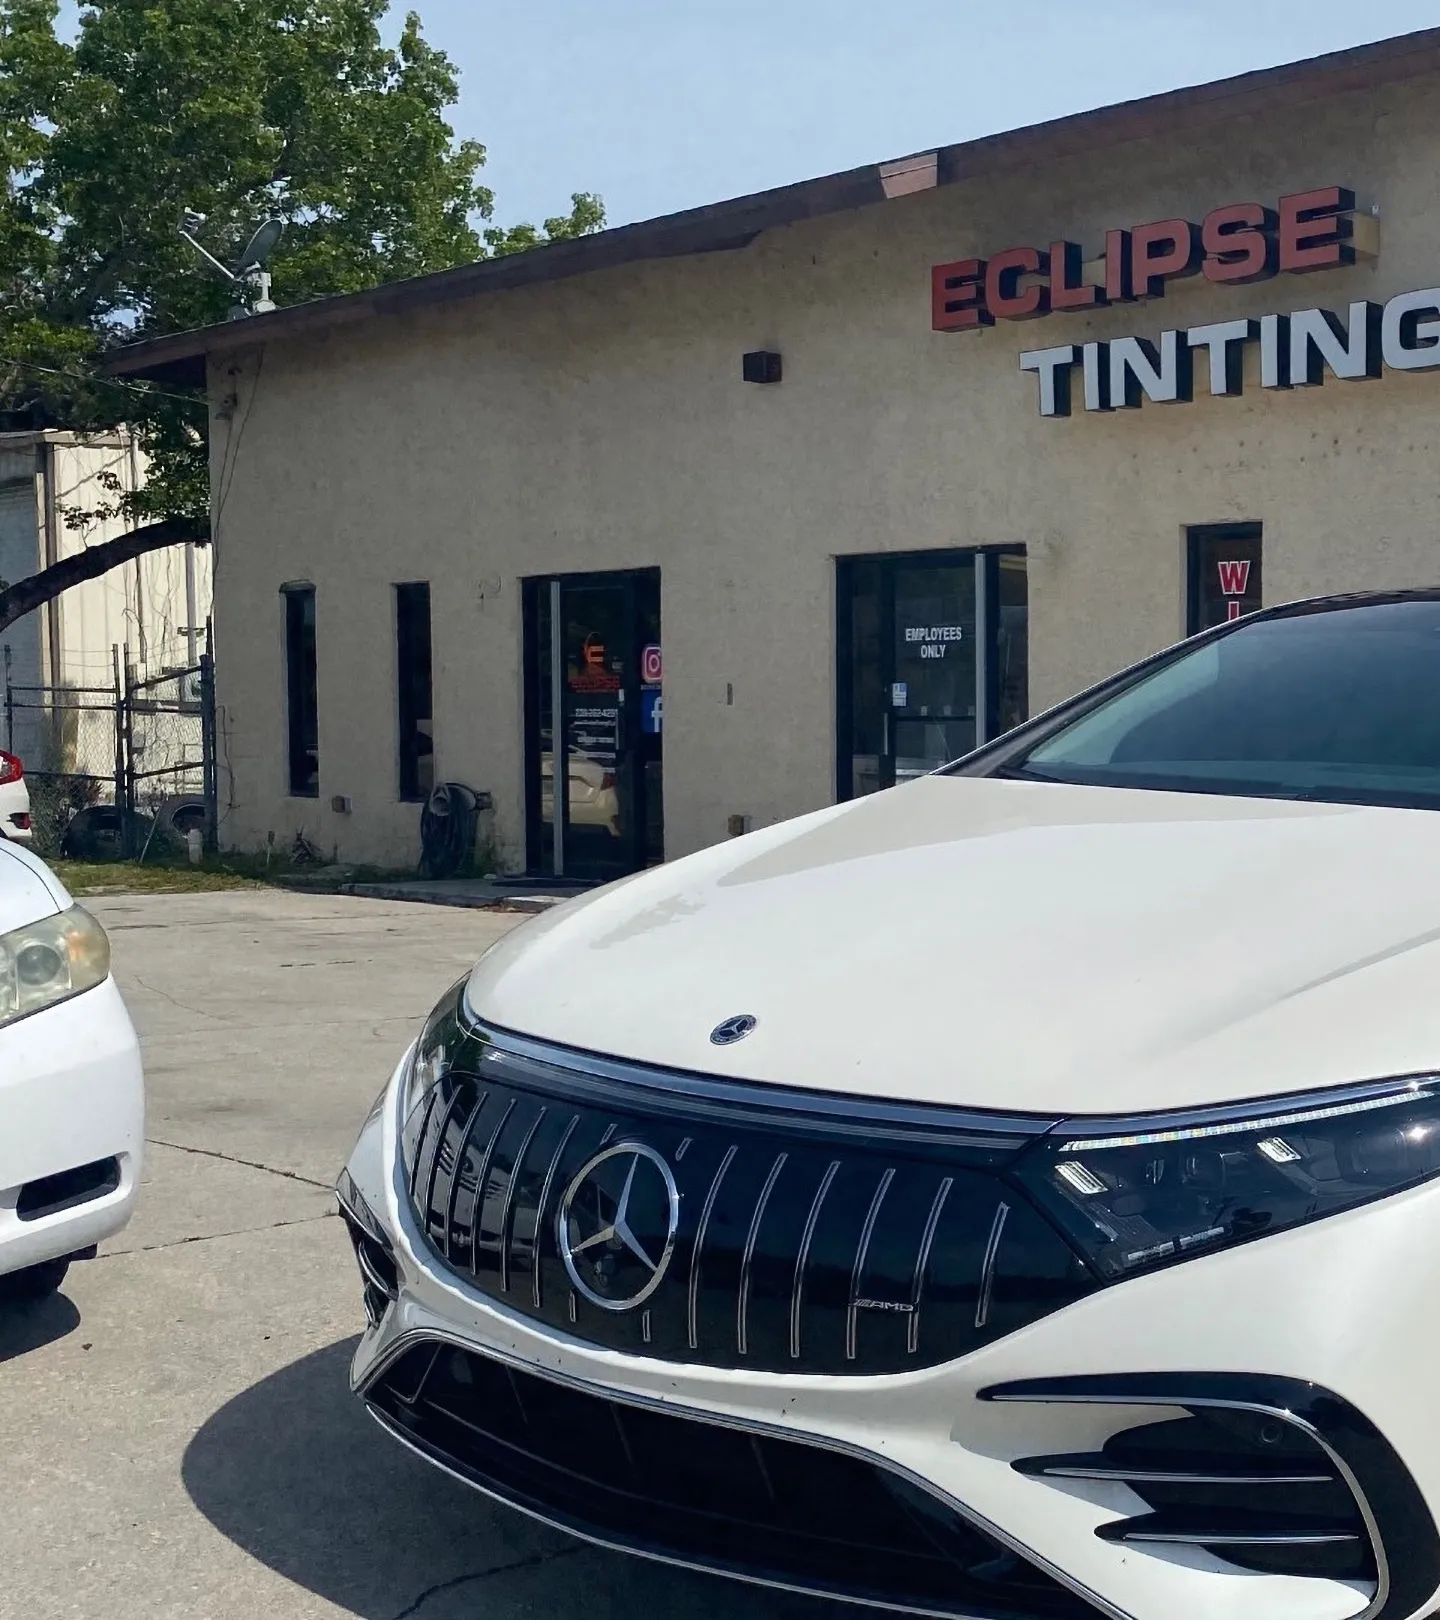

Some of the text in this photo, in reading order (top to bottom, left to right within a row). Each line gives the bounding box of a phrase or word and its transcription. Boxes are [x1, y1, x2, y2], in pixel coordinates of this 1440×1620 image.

[931, 186, 1356, 333] ECLIPSE
[905, 627, 962, 641] EMPLOYEES
[920, 645, 946, 658] ONLY
